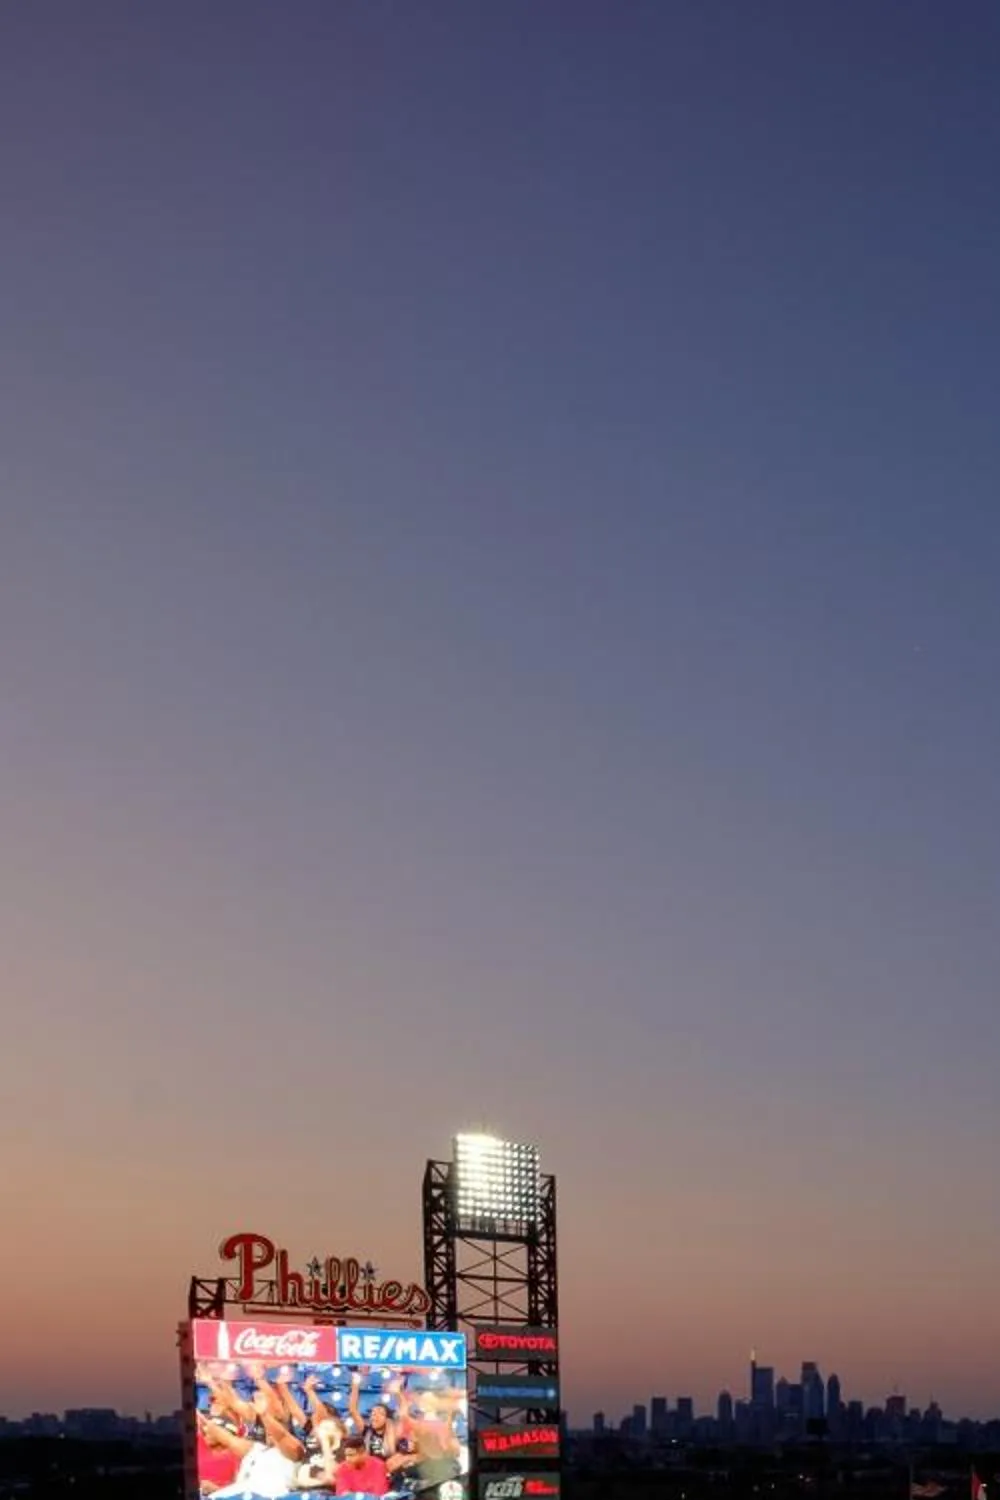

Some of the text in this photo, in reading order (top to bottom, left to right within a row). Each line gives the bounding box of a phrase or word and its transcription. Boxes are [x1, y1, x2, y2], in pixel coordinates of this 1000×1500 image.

[219, 1233, 431, 1314] Phillies
[234, 1327, 321, 1357] Coca-Cola
[340, 1333, 463, 1363] RE/MAX
[500, 1335, 556, 1350] TOYOTA
